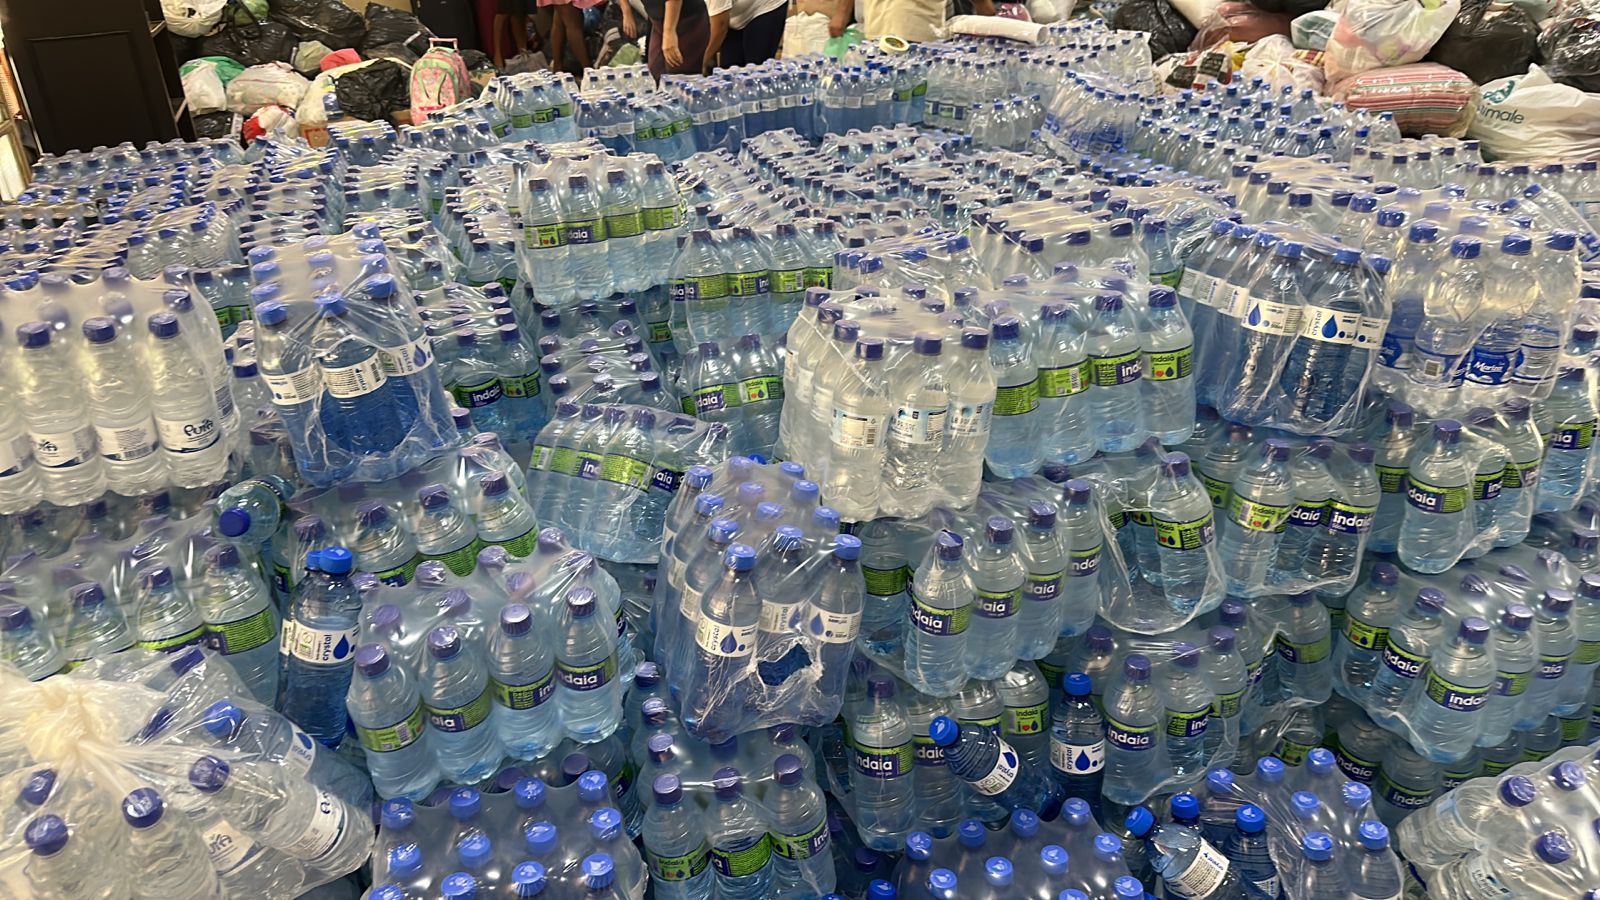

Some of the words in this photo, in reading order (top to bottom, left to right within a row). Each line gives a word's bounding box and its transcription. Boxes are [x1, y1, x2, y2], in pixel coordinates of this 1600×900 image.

[697, 395, 719, 407] daia
[1408, 488, 1436, 506] daia
[1291, 508, 1321, 521] daia
[1026, 582, 1055, 596] daia
[322, 633, 332, 661] crystal
[1107, 726, 1150, 746] indaia
[1065, 746, 1074, 770] crystal
